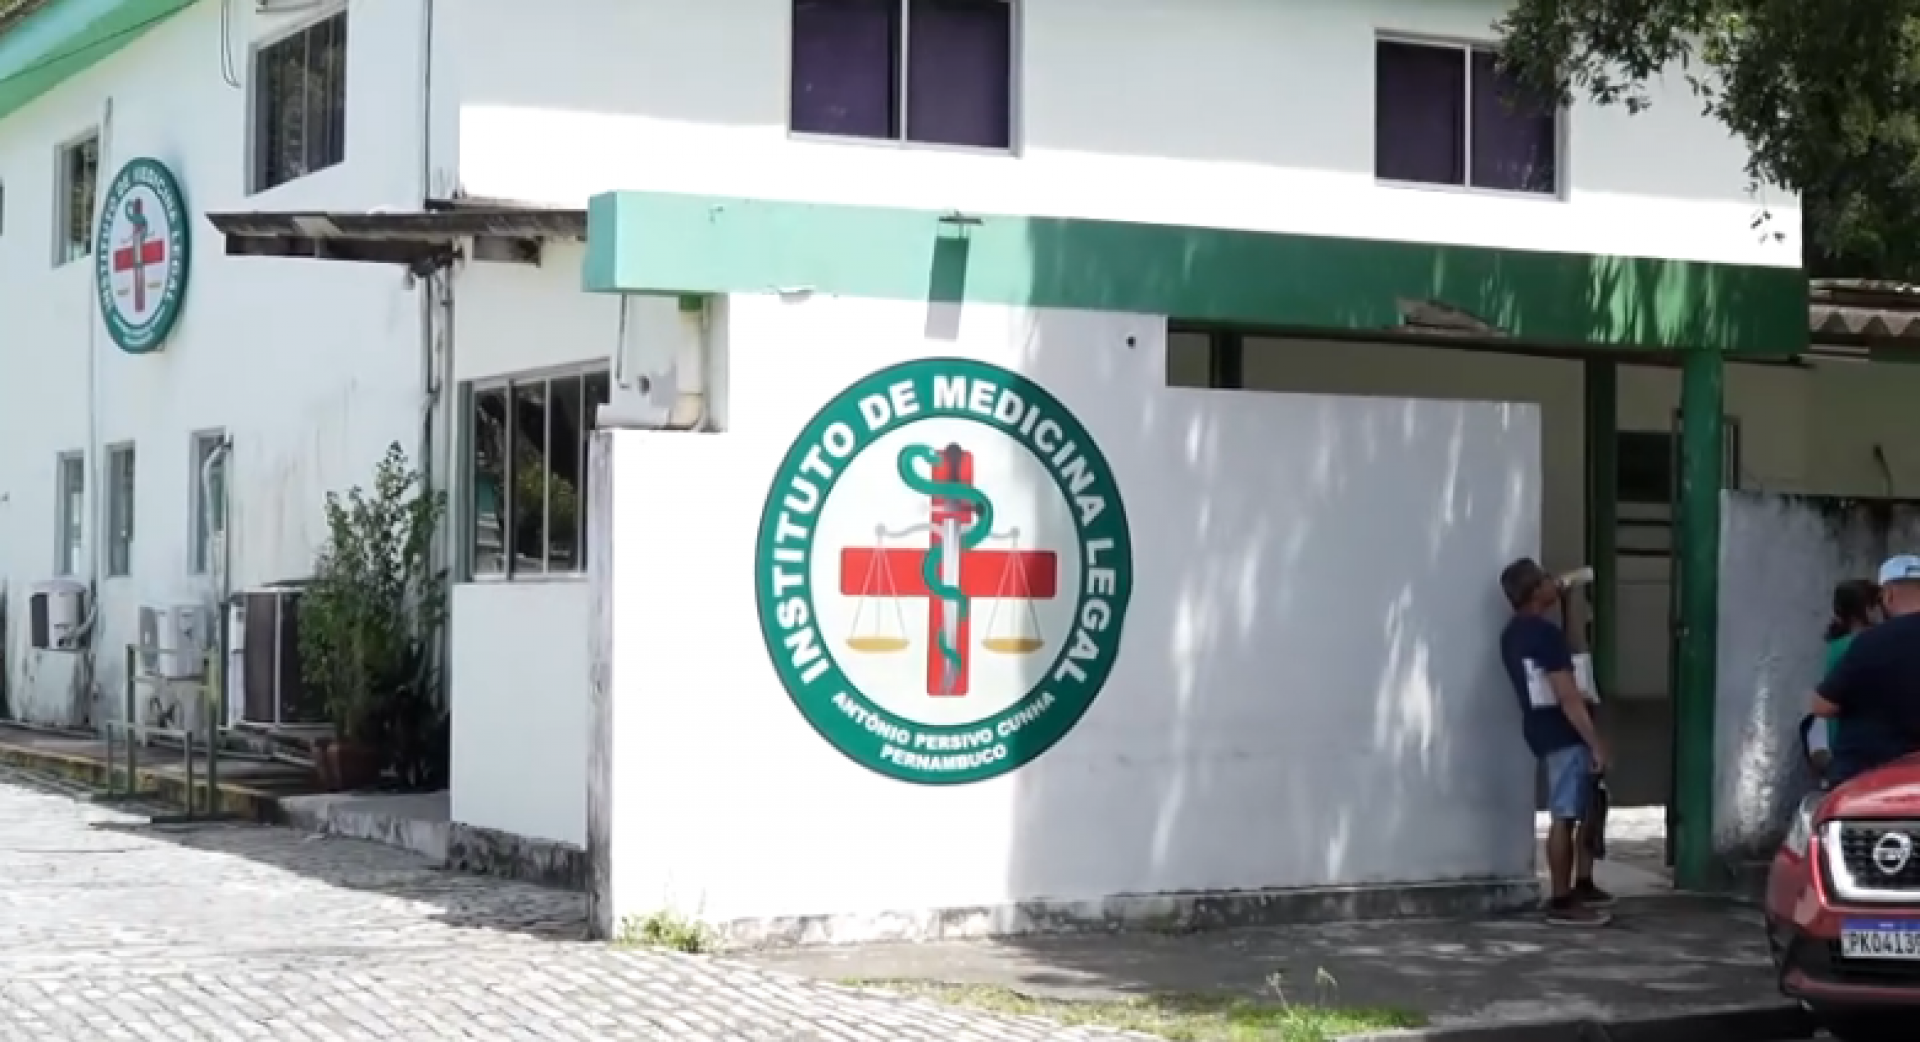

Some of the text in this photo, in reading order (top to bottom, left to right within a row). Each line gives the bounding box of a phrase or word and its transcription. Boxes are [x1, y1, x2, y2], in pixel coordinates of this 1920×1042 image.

[772, 375, 1116, 685] INSTITUTO DE MEDICINA LEGAL
[914, 728, 994, 750] PERSIVO
[997, 691, 1056, 736] CUNHA
[879, 743, 1008, 771] PERNAMBUCO
